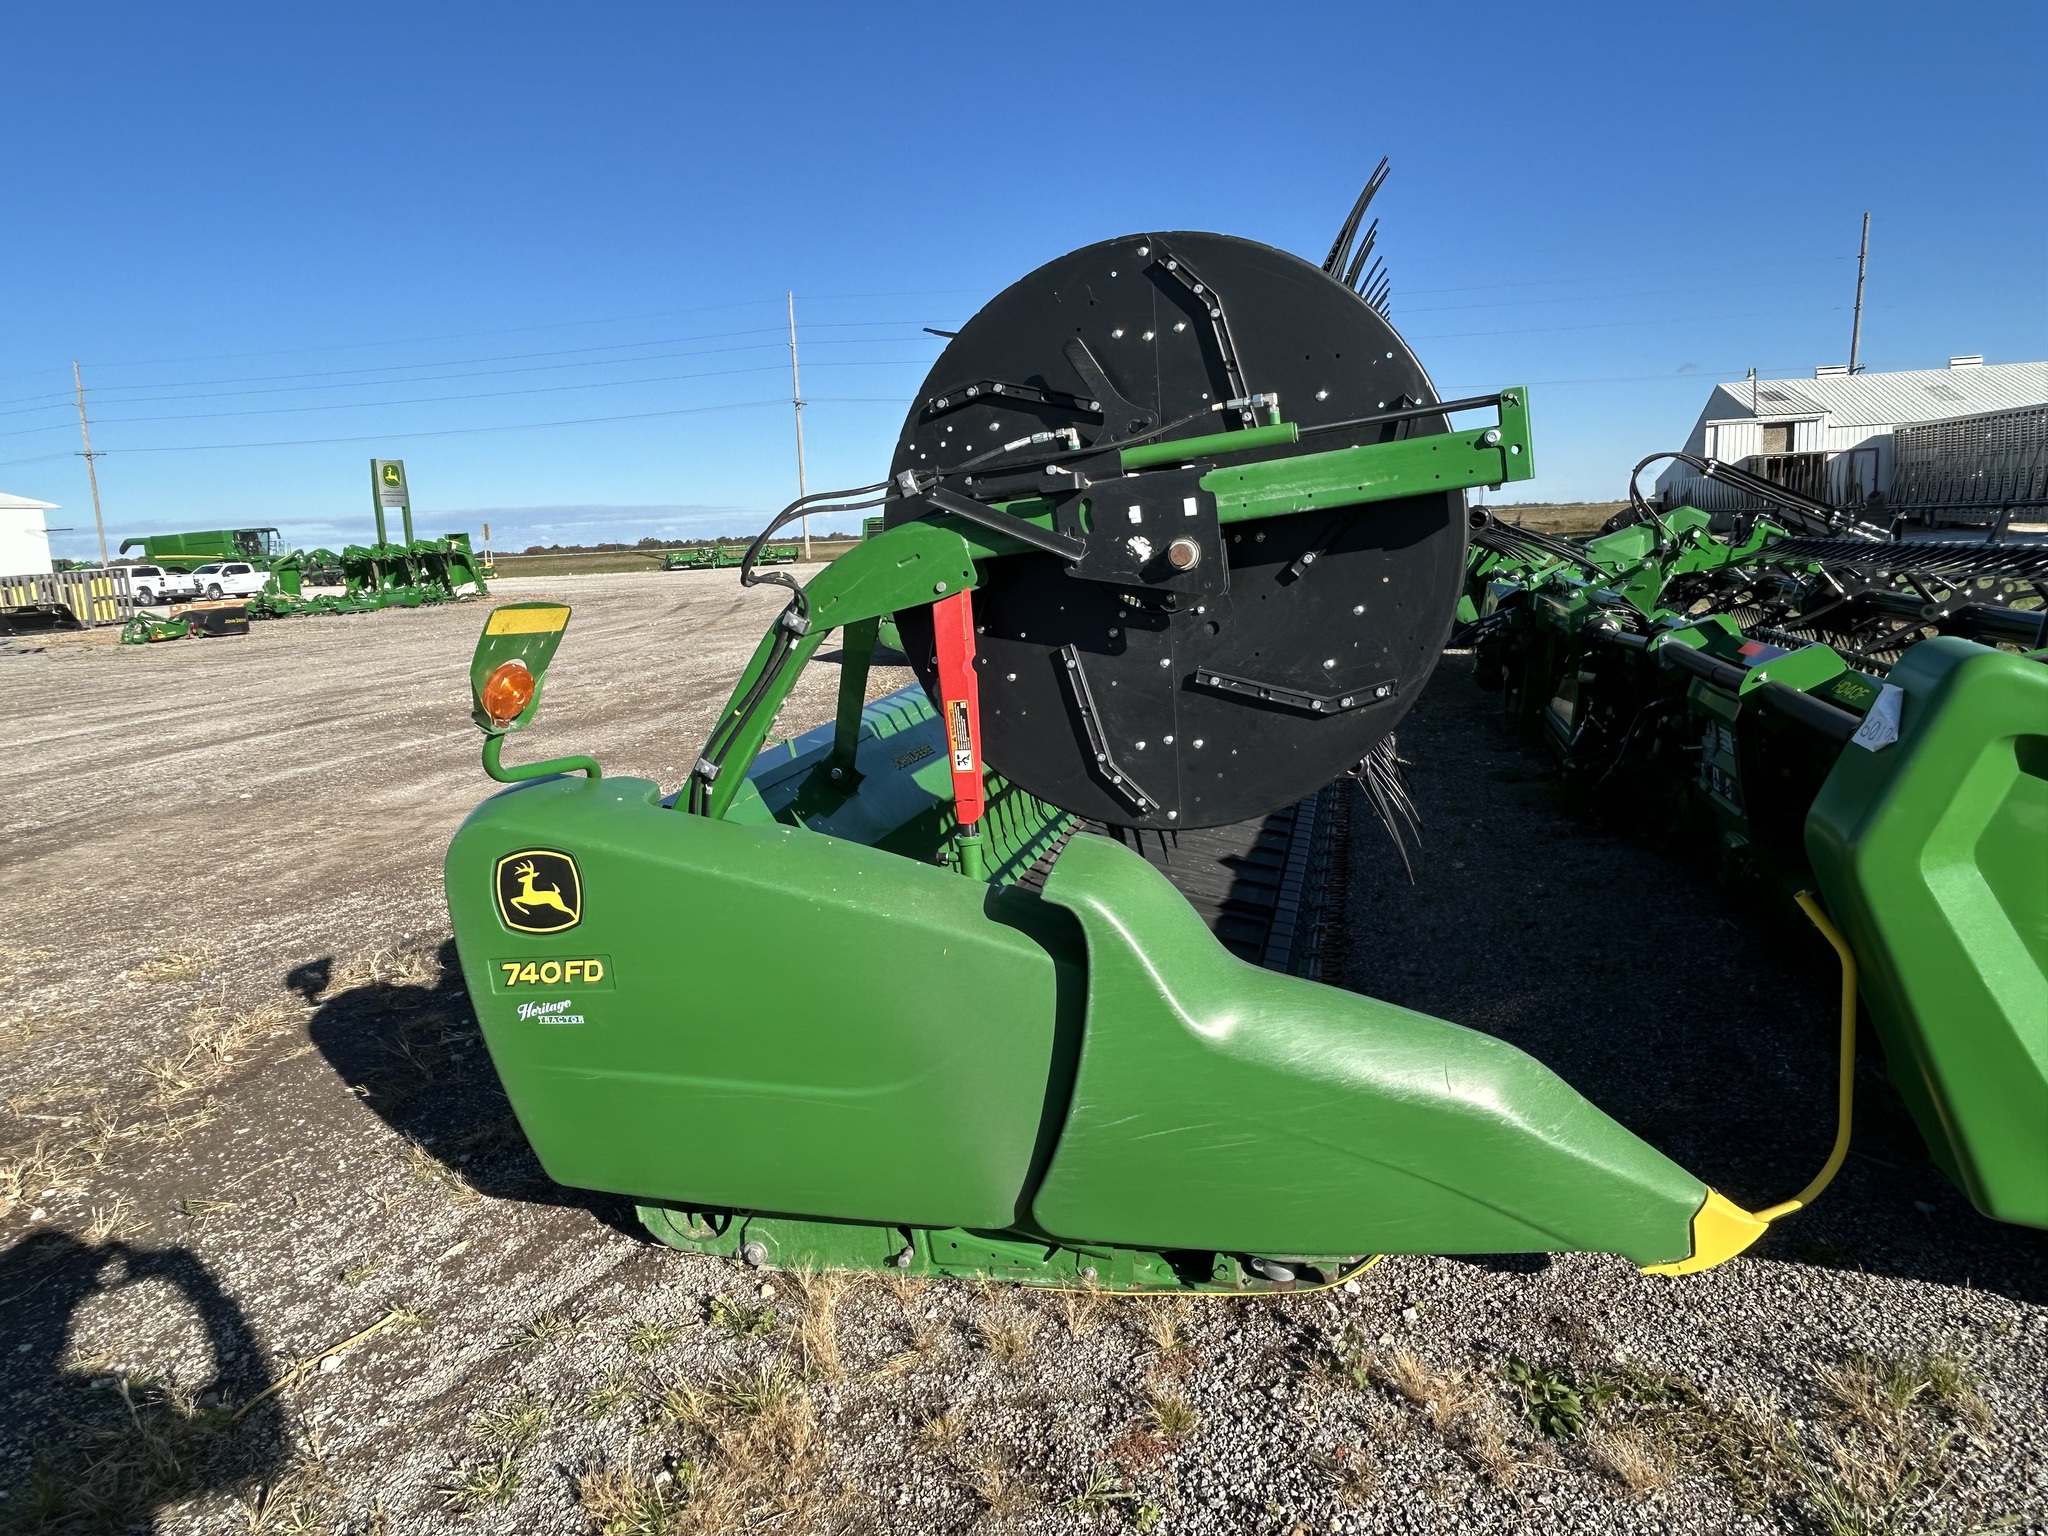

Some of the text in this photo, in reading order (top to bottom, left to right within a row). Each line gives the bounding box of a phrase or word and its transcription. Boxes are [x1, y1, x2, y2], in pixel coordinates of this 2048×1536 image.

[501, 959, 604, 987] 740FD
[517, 999, 572, 1022] Heritage
[538, 1015, 585, 1025] TRACTOR
